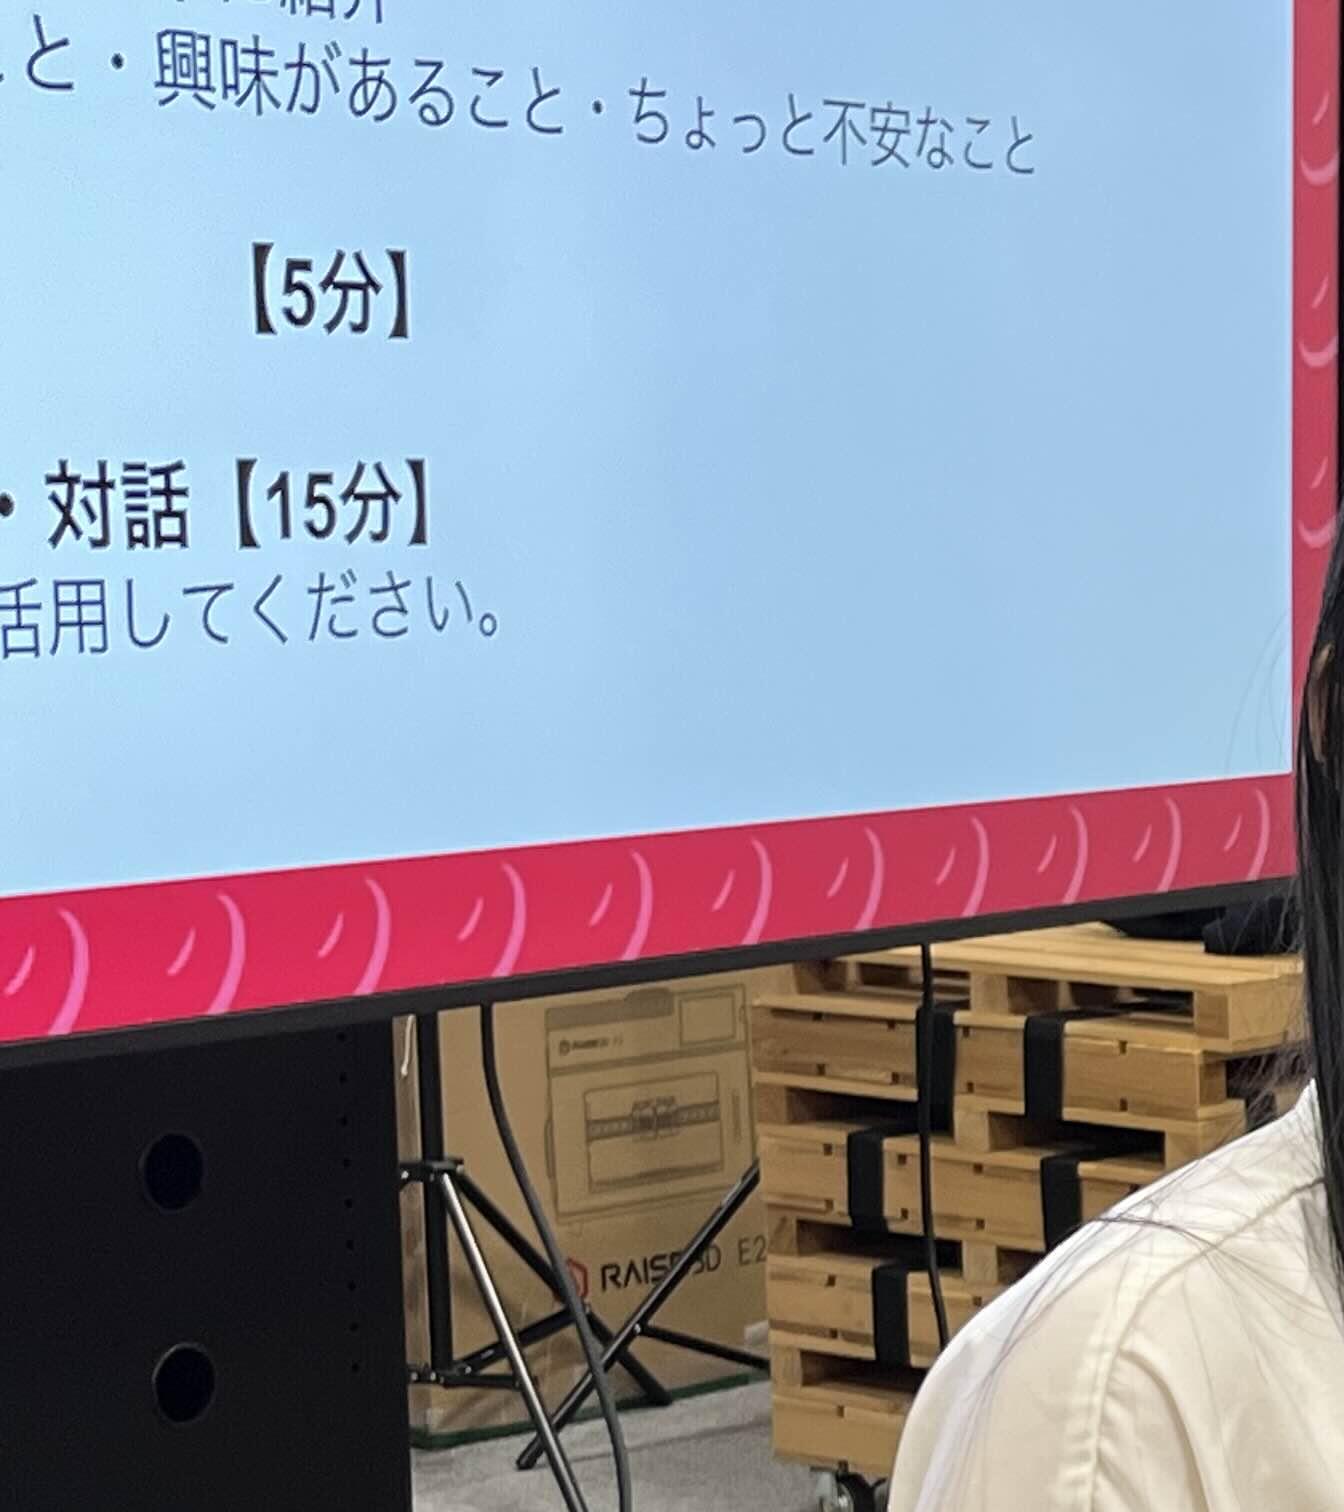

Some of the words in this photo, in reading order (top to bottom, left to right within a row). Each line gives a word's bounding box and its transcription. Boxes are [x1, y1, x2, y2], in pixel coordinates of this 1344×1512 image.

[0, 14, 1034, 174] と・興味があること・ちょっと不安なこと
[253, 242, 408, 339] 【5分】
[0, 568, 499, 660] 活用してください。
[601, 1242, 721, 1292] RAISD
[738, 1234, 767, 1266] E2
